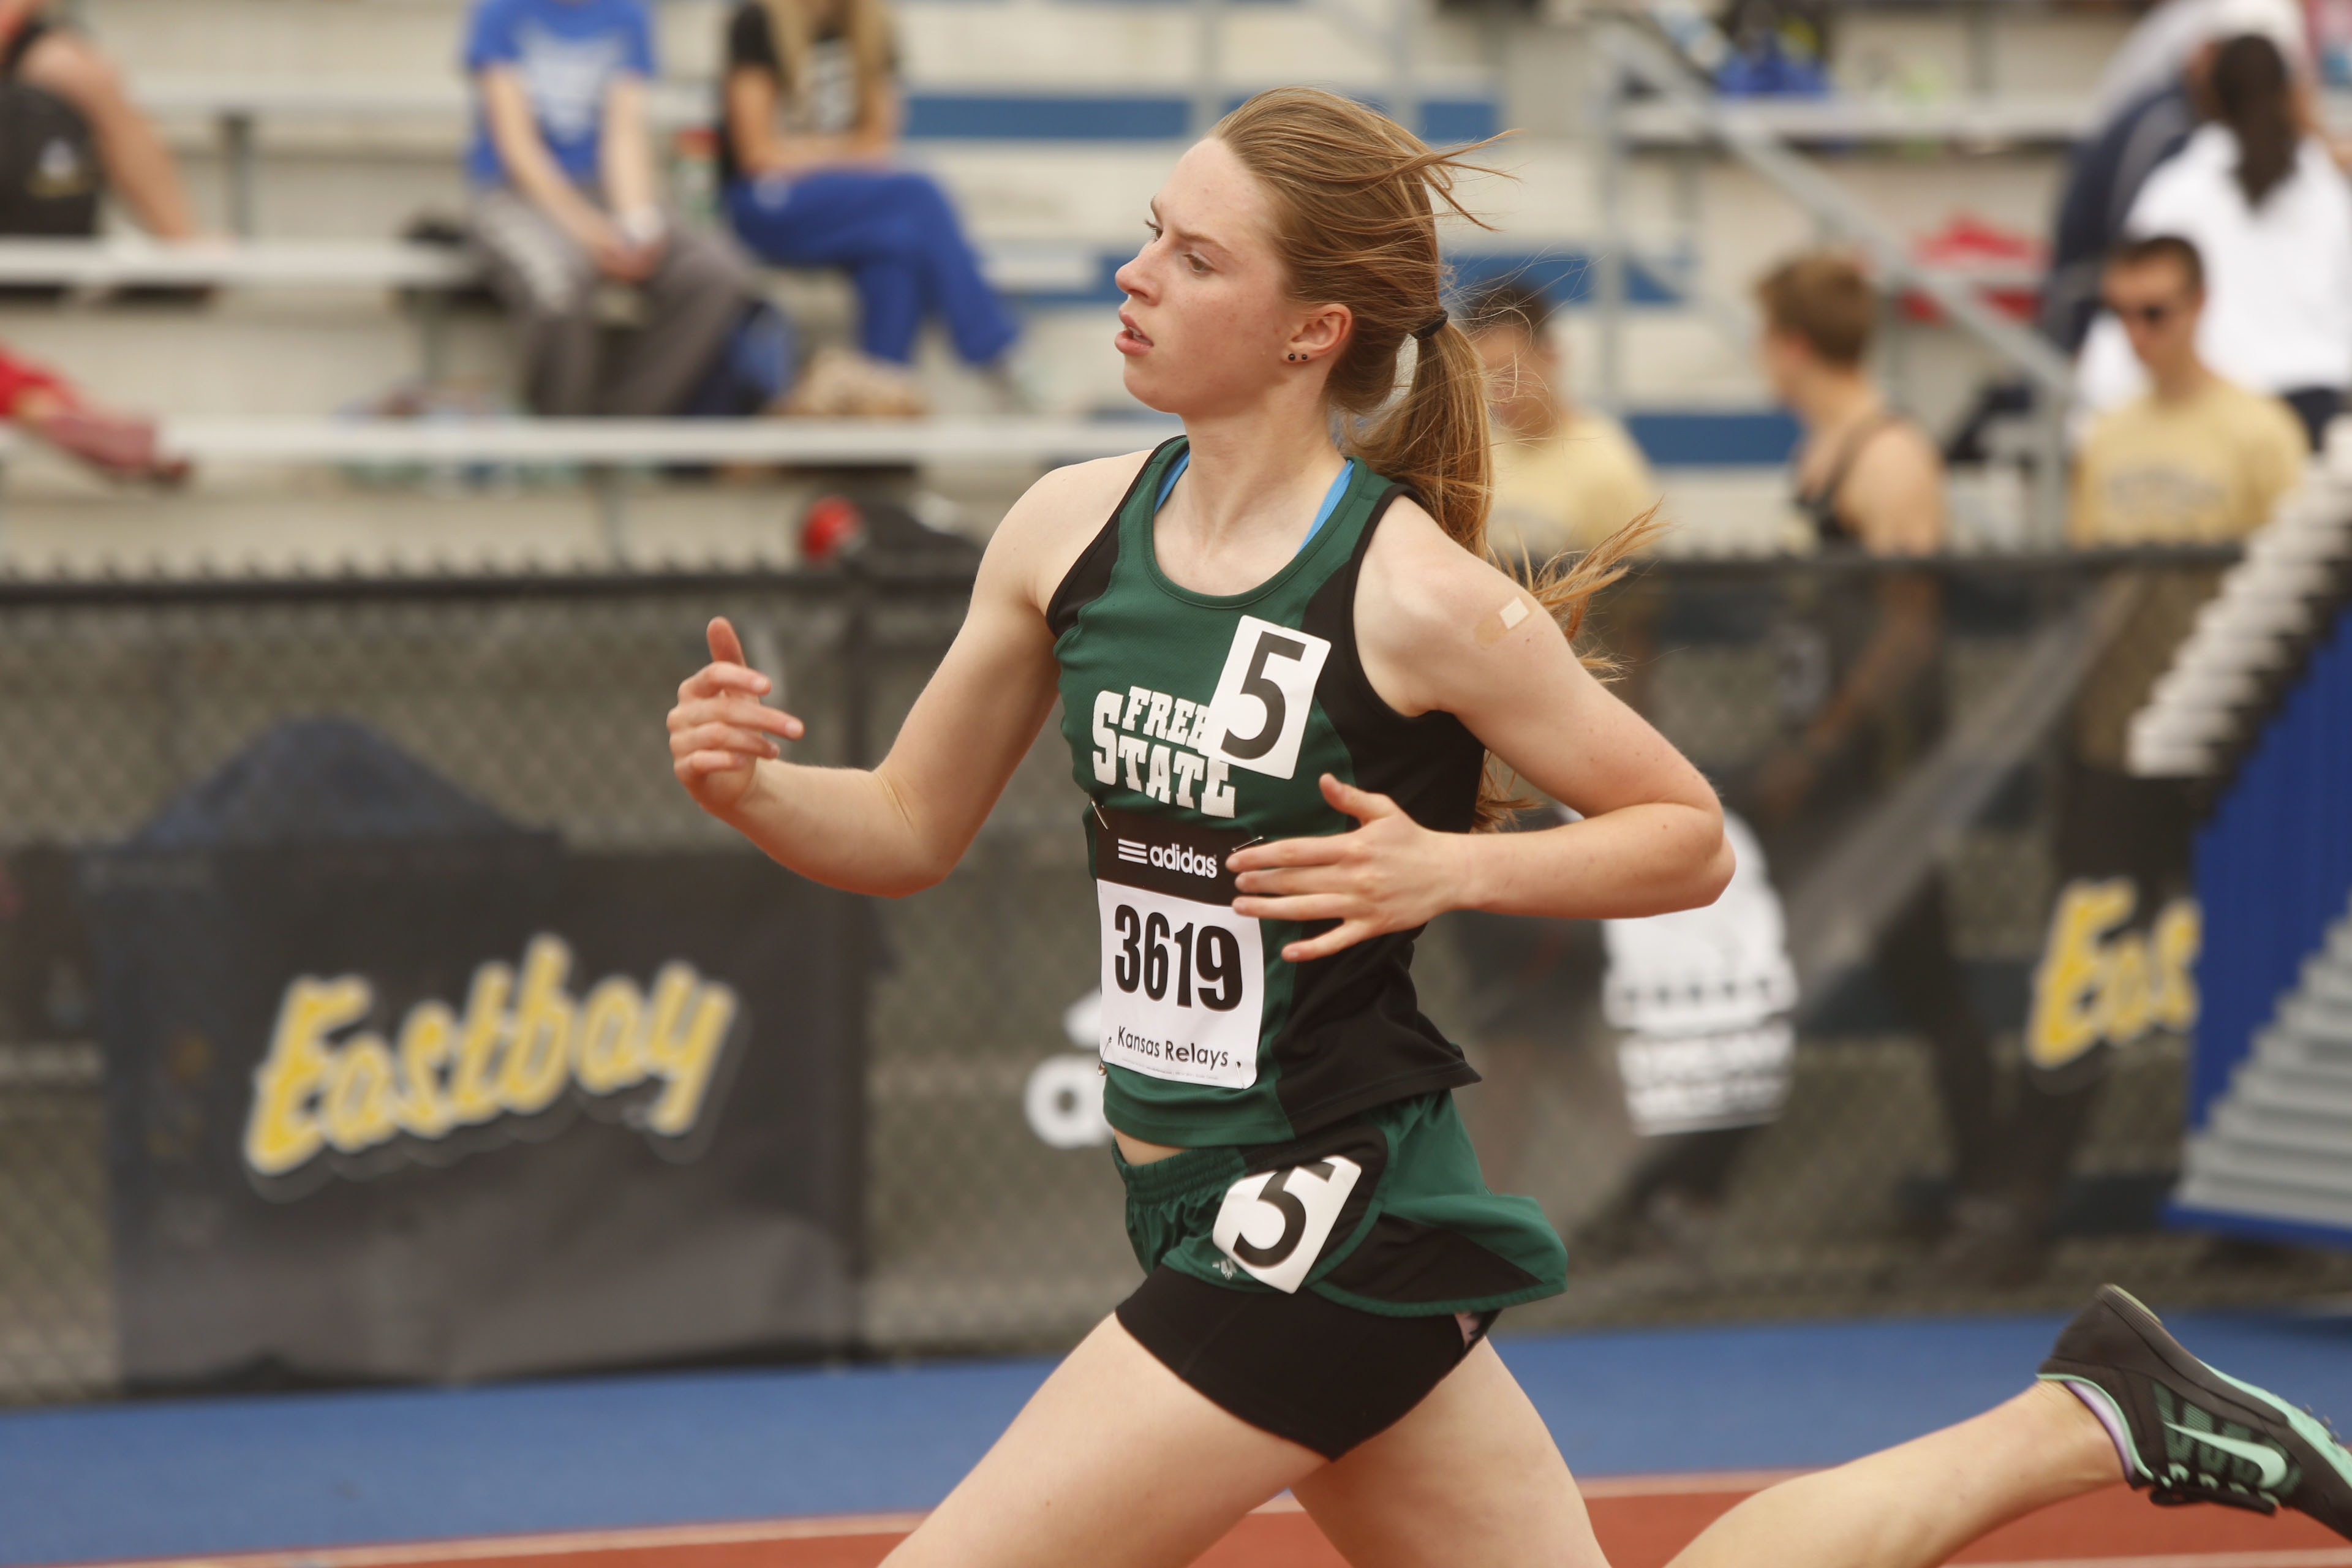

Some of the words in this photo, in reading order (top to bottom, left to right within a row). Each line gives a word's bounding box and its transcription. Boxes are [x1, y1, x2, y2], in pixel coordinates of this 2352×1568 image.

[1221, 631, 1306, 760] 5
[1092, 690, 1236, 818] STATE
[1150, 843, 1218, 878] adidas
[1114, 904, 1243, 1012] 3619
[245, 933, 736, 1176] Eastbay
[1117, 1025, 1161, 1058] Kansas
[1165, 1040, 1229, 1071] Relays
[1232, 1161, 1336, 1268] 5
